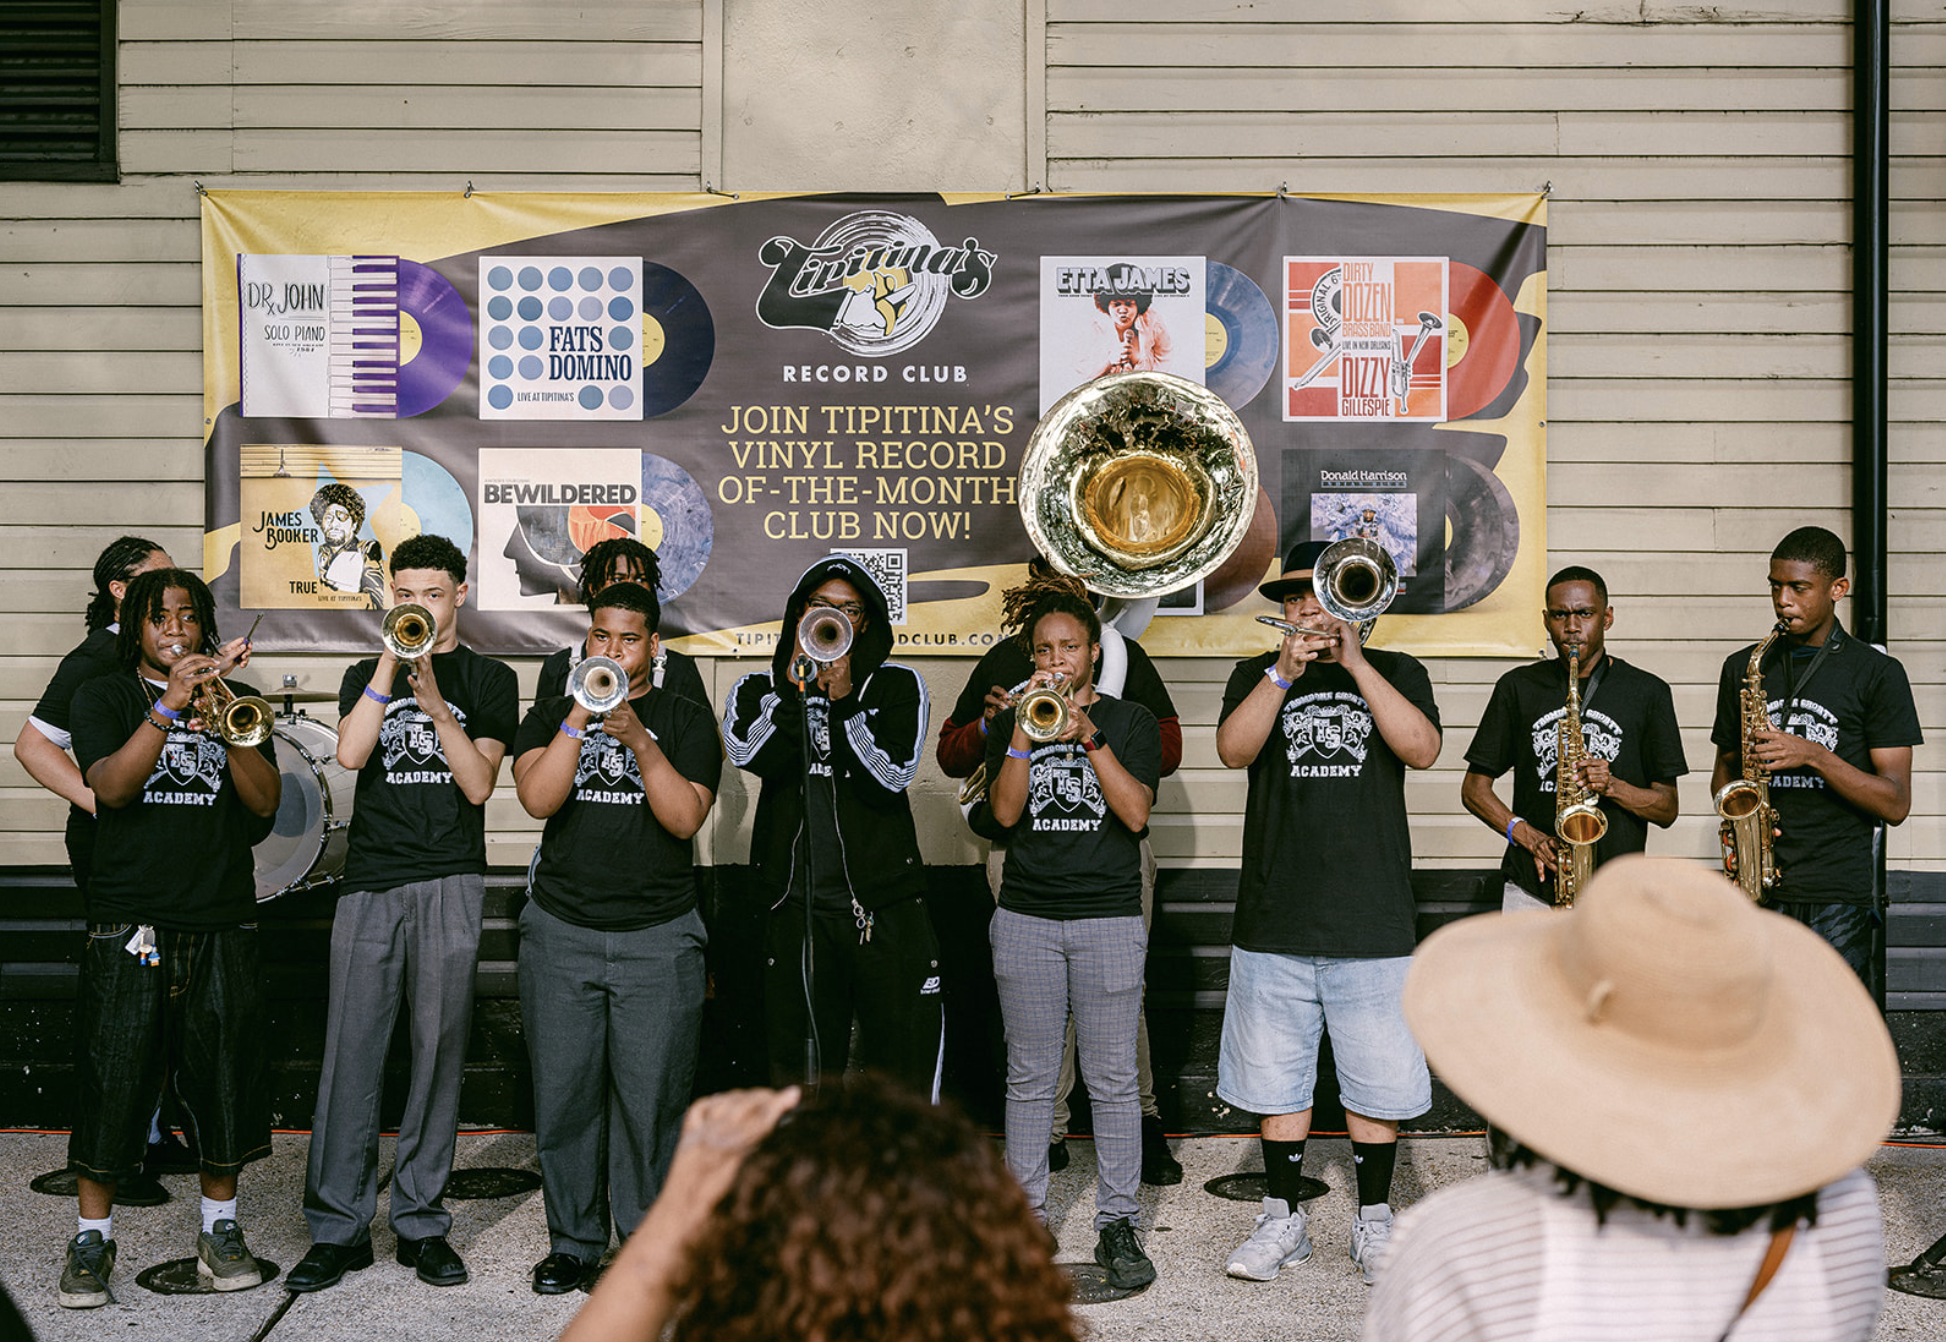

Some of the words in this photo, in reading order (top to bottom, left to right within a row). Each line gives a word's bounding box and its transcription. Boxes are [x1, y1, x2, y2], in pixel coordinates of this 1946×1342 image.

[1056, 266, 1116, 294] ETTA
[1113, 266, 1191, 294] JAMES
[1343, 262, 1375, 282] DIRTY
[756, 236, 998, 333] Tipitina's
[277, 283, 325, 314] JOHN
[1342, 283, 1391, 322] DOZEN
[264, 325, 290, 341] SOLO
[294, 325, 326, 342] PIANO
[549, 326, 603, 352] FATS
[1342, 323, 1369, 338] BRASS
[1369, 323, 1391, 338] BAND
[548, 354, 632, 381] DOMINO
[783, 365, 888, 383] RECORD
[902, 365, 968, 383] CLUB
[1342, 357, 1391, 398] DIZZY
[517, 392, 531, 402] LIVE
[532, 392, 540, 402] AT
[1342, 399, 1390, 417] GILLESPIE
[721, 406, 809, 434] JOIN
[821, 405, 1014, 434] TIPITINA’S
[729, 441, 843, 469] VINYL
[855, 441, 1007, 469] RECORD
[1320, 470, 1358, 480] Donald
[1360, 470, 1407, 480] Harrison
[484, 484, 637, 504] BEWILDERED
[718, 476, 1017, 504] OF-THE-MONTH
[252, 511, 302, 533] JAMES
[764, 511, 861, 539] CLUB
[873, 511, 970, 539] NOW!
[265, 528, 318, 550] BOOKER
[289, 581, 318, 594] TRUE
[385, 771, 454, 785] ACADEMY
[1290, 765, 1363, 778] ACADEMY
[1768, 775, 1825, 789] ADEMY
[143, 791, 217, 807] ACADEMY
[575, 788, 645, 805] ACADEMY
[1032, 818, 1103, 832] ACADEMY
